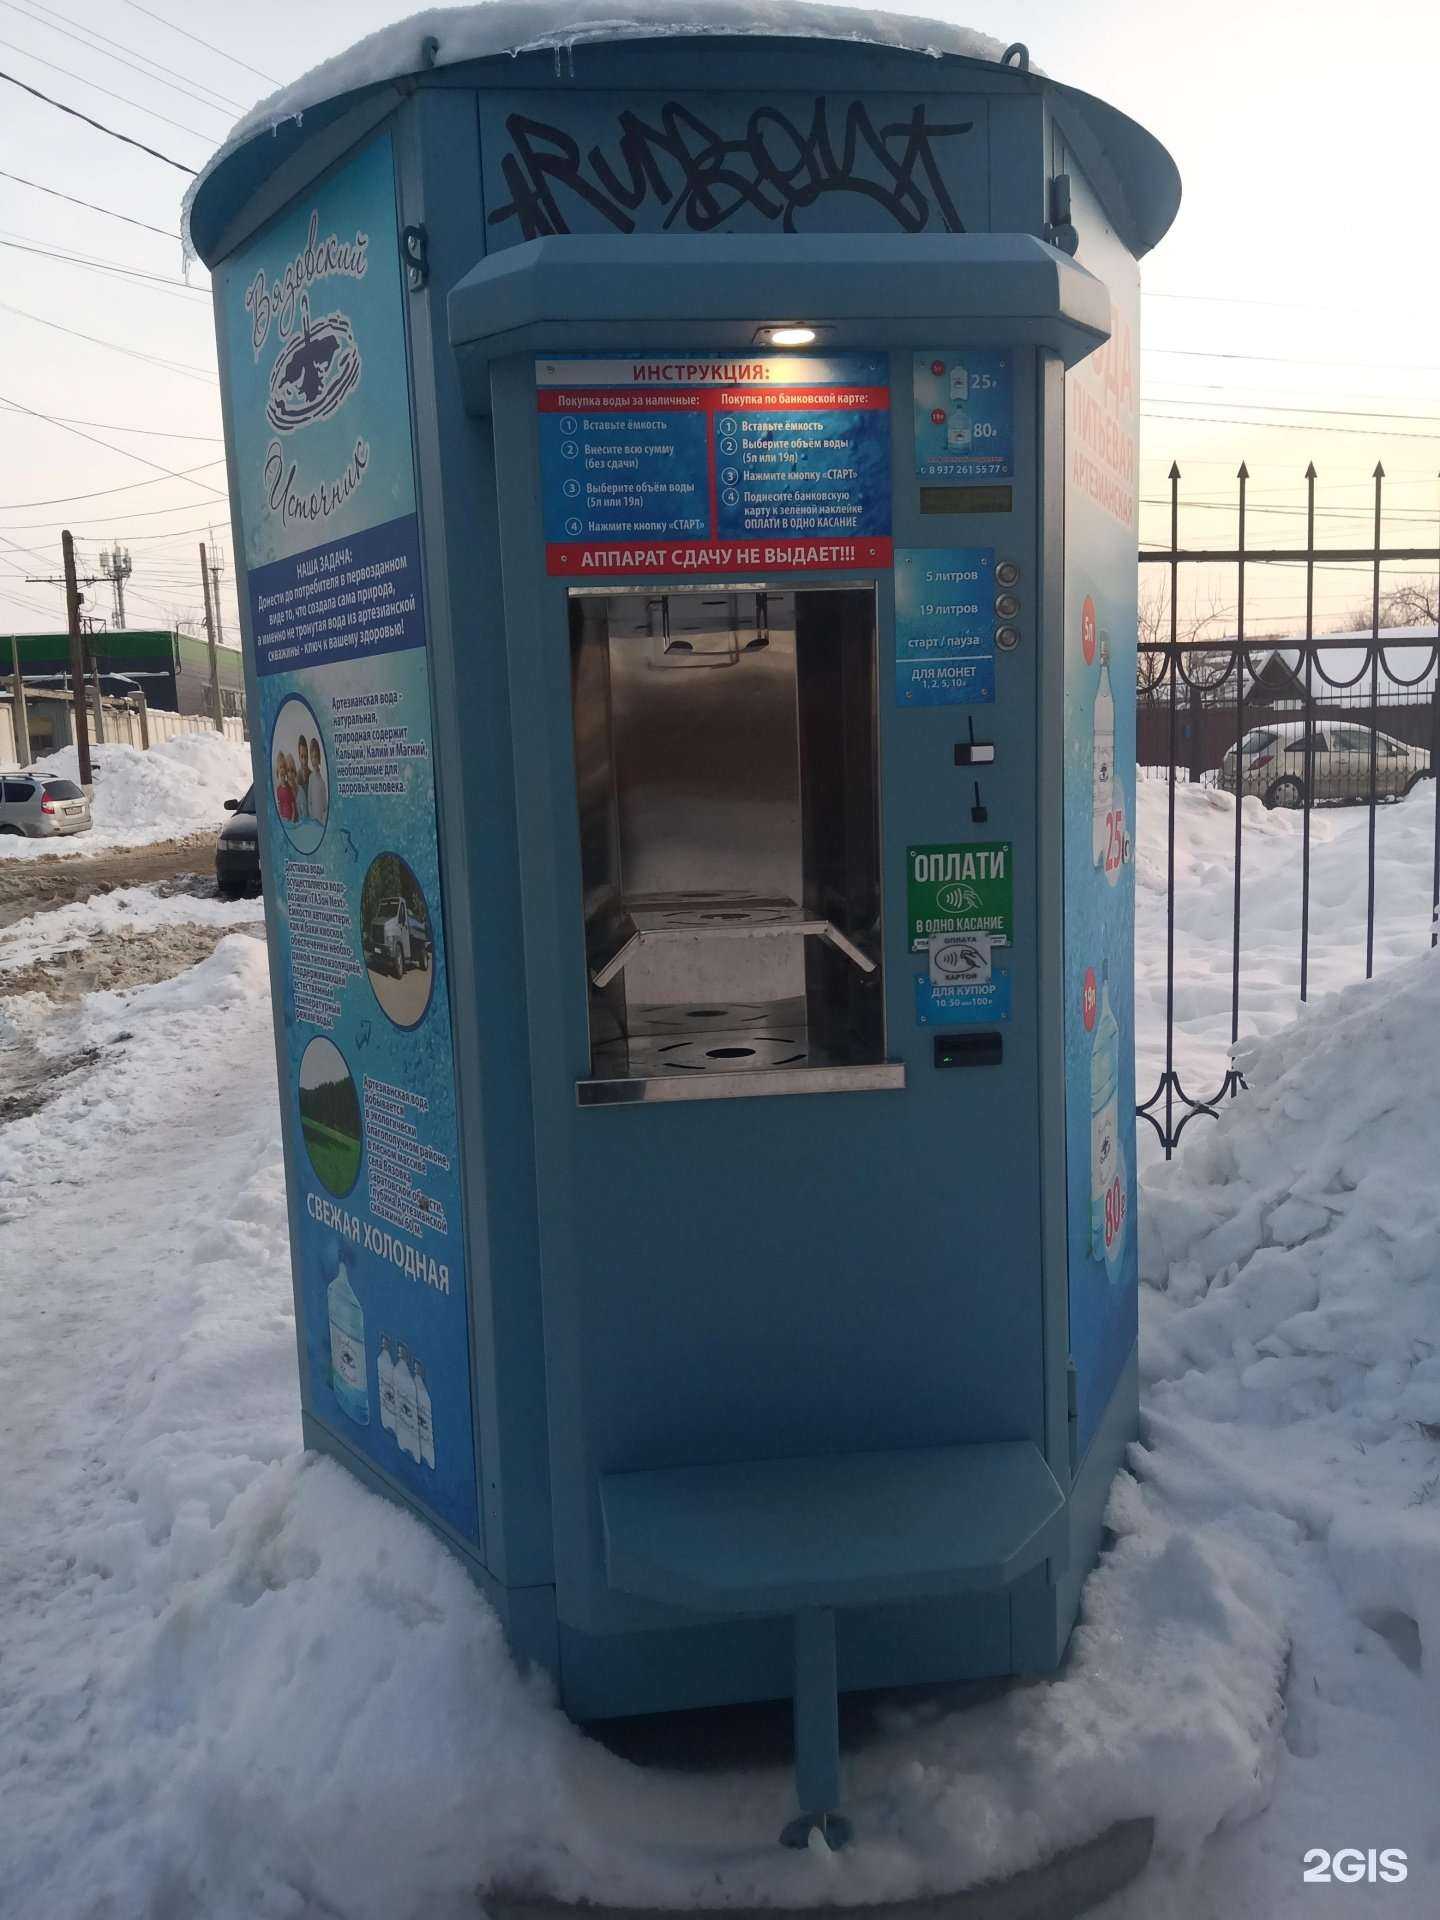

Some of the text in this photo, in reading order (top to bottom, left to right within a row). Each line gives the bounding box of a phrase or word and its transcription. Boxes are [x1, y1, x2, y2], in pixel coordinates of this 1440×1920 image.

[633, 363, 771, 383] ИНСТРУКЦИЯ:
[558, 395, 701, 409] Покупка воды за наличные:
[721, 393, 869, 408] Покупка по банковской карте:
[583, 418, 668, 432] Вставьте ёмкость
[741, 420, 824, 433] Вставьте ёмкость
[584, 444, 675, 457] Внесите всю сумму
[742, 437, 849, 452] Выберите объём воды
[585, 459, 640, 472] (без сдачи)
[742, 452, 798, 466] (5л или 19л)
[743, 468, 858, 483] Нажмите кнопку «СТАРТ»
[929, 463, 1000, 474] 8 937 261 55 77
[264, 441, 369, 528] Источник
[586, 481, 696, 495] Выберите объём воды
[586, 495, 645, 509] (5л или 19л)
[744, 490, 850, 503] Поднесите банковскую
[744, 506, 771, 518] карту
[773, 506, 778, 515] к
[818, 503, 863, 515] наклейке
[588, 518, 706, 534] Нажмите кнопку «СТАРТ»
[744, 516, 858, 530] ОПЛАТИ В ОДНО КАСАНИЕ
[296, 547, 353, 579] НАША ЗАДАЧА:
[580, 545, 856, 568] АППАРАТ СДАЧУ НЕ ВЫДАЕТ!!!
[258, 592, 285, 613] Донести
[285, 588, 294, 602] до
[294, 576, 340, 601] потребителя
[346, 556, 408, 586] первозданном
[926, 570, 979, 584] 5 литров
[269, 581, 396, 626] виде то, что создала сама природа,
[920, 603, 979, 617] 19 литров
[262, 628, 287, 645] именно
[286, 626, 296, 641] не
[296, 619, 327, 640] тронутая
[327, 614, 346, 631] вода
[347, 612, 357, 625] из
[357, 592, 416, 625] артезианской
[268, 643, 300, 663] скважины
[304, 642, 323, 656] ключ
[328, 631, 359, 651] вашему
[359, 618, 405, 645] здоровью!
[908, 638, 940, 651] старт
[947, 634, 981, 649] пауза
[912, 666, 977, 682] ДЛЯ МОНЕТ
[332, 691, 398, 712] Артезианская вода
[333, 711, 378, 730] натуральная,
[334, 726, 408, 746] природная содержит
[367, 743, 389, 758] Калий
[396, 740, 428, 758] Магний,
[336, 763, 383, 780] необходимые
[338, 780, 406, 798] здоровья человека.
[914, 851, 1005, 883] ОПЛАТИ
[916, 915, 1004, 934] В ОДНО КАСАНИЕ
[931, 984, 996, 999] ДЛЯ КУПЮР
[363, 1075, 410, 1104] Артезианская
[364, 1093, 404, 1116] добывается
[371, 1110, 417, 1138] экологически
[366, 1121, 420, 1153] благополучном
[306, 1192, 450, 1295] СВЕЖАЯ ХОЛОДНАЯ
